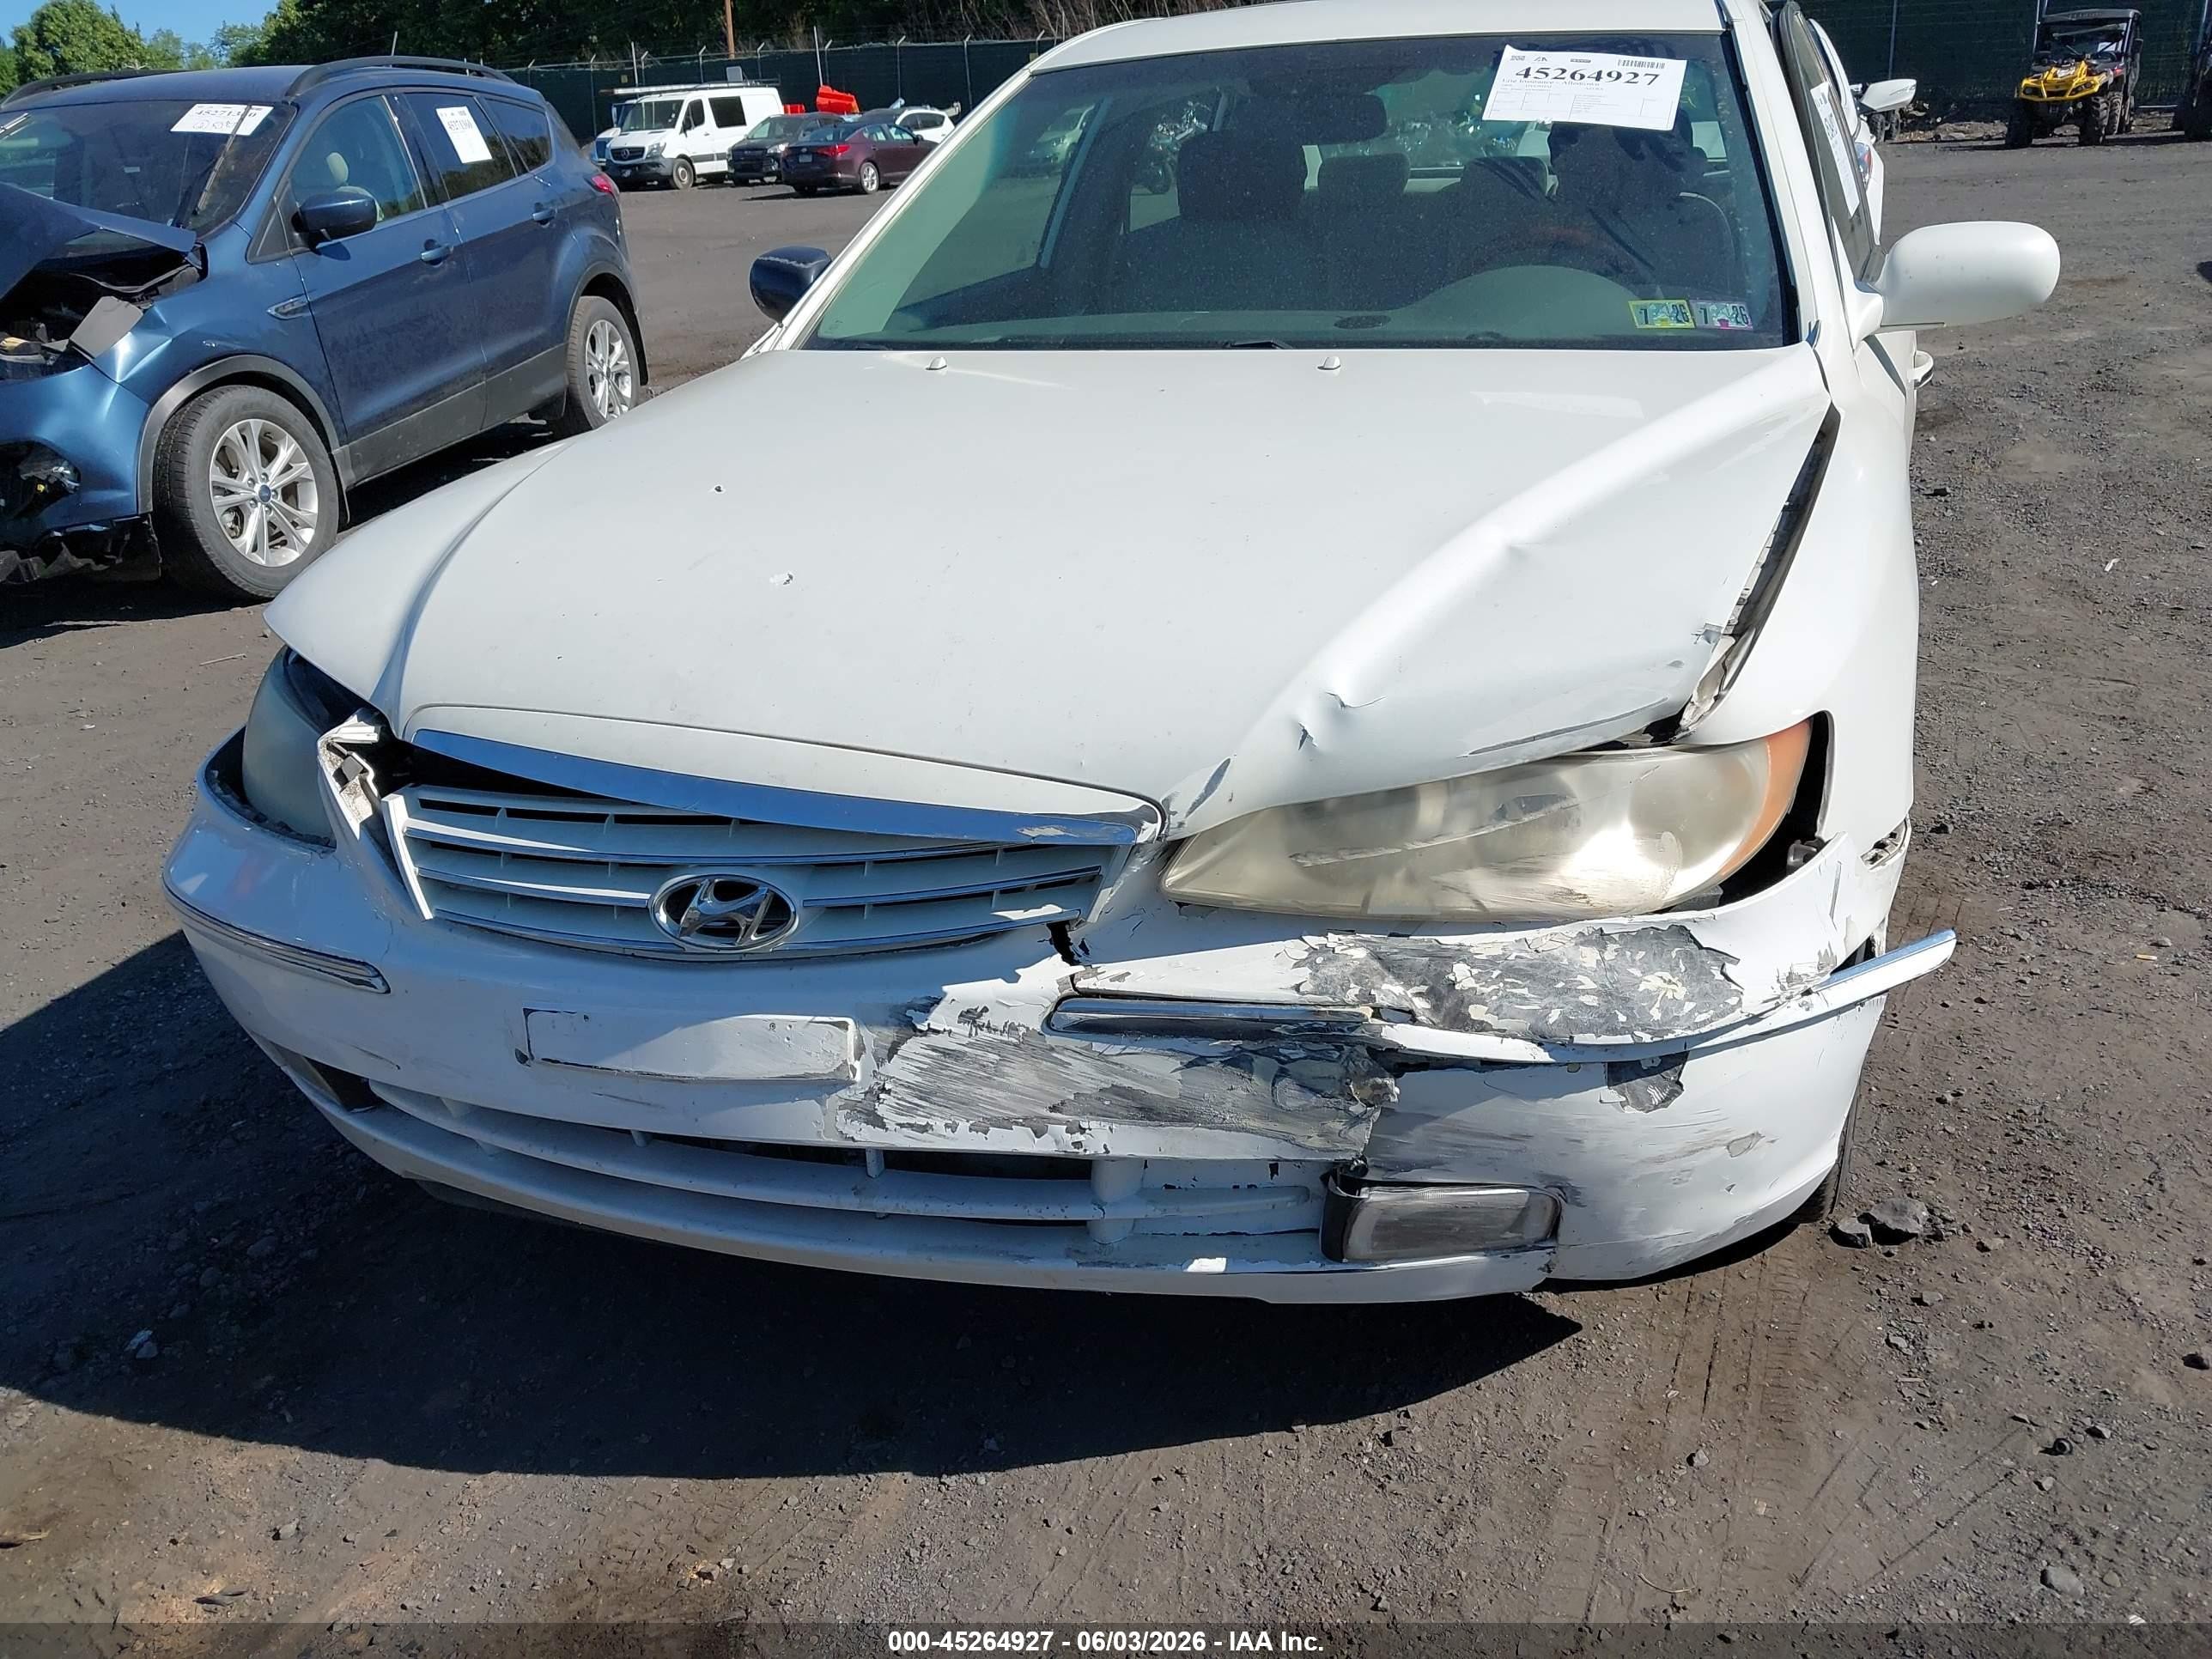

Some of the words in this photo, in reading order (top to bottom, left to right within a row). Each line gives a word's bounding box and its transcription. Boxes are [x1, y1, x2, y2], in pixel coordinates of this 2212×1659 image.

[1516, 66, 1660, 86] 45264927
[195, 109, 257, 118] 4527130
[1672, 304, 1690, 323] 26
[1732, 306, 1749, 325] 26
